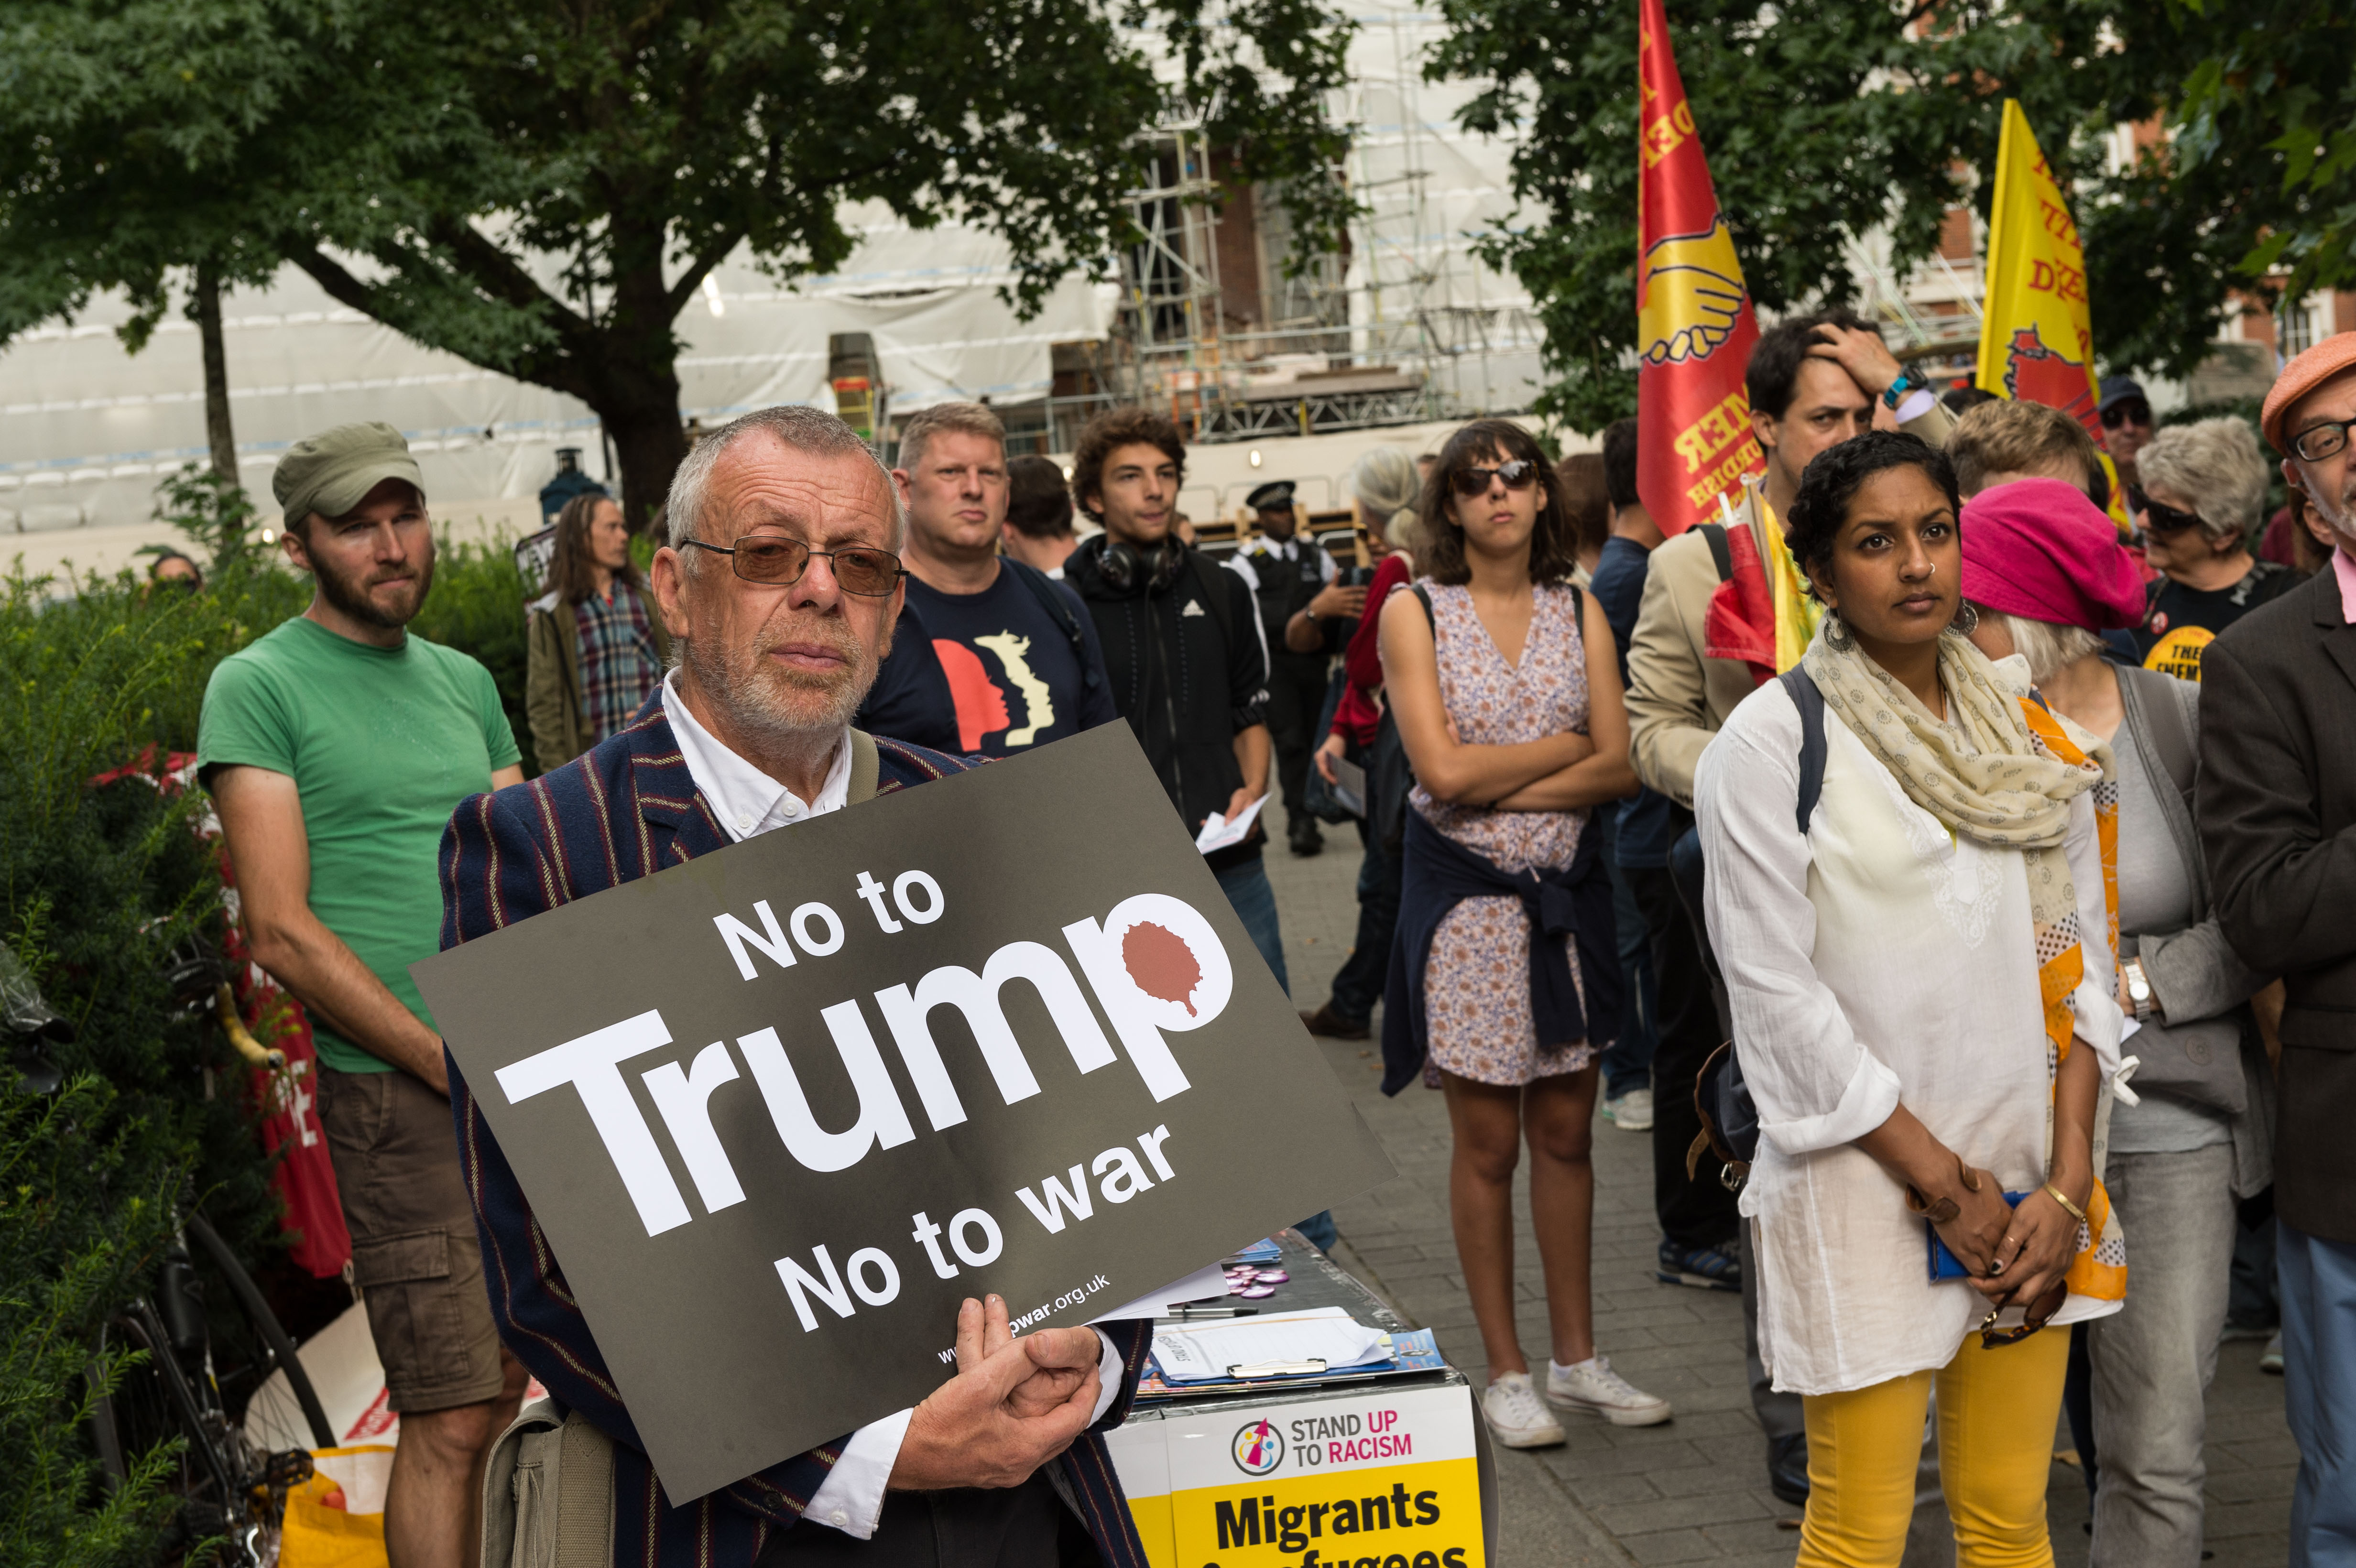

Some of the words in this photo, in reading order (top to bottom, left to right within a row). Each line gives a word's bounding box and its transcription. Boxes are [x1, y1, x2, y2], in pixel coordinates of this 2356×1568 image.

[713, 900, 845, 981] No
[856, 870, 945, 934] to
[494, 893, 1233, 1238] Trump
[774, 1244, 900, 1333] No
[912, 1208, 1003, 1280] to
[1014, 1124, 1176, 1234] war
[1291, 1414, 1361, 1442] STAND
[1368, 1410, 1398, 1433] UP
[1293, 1444, 1322, 1467] TO
[1329, 1434, 1412, 1463] RACISM
[1214, 1483, 1440, 1554] Migrants
